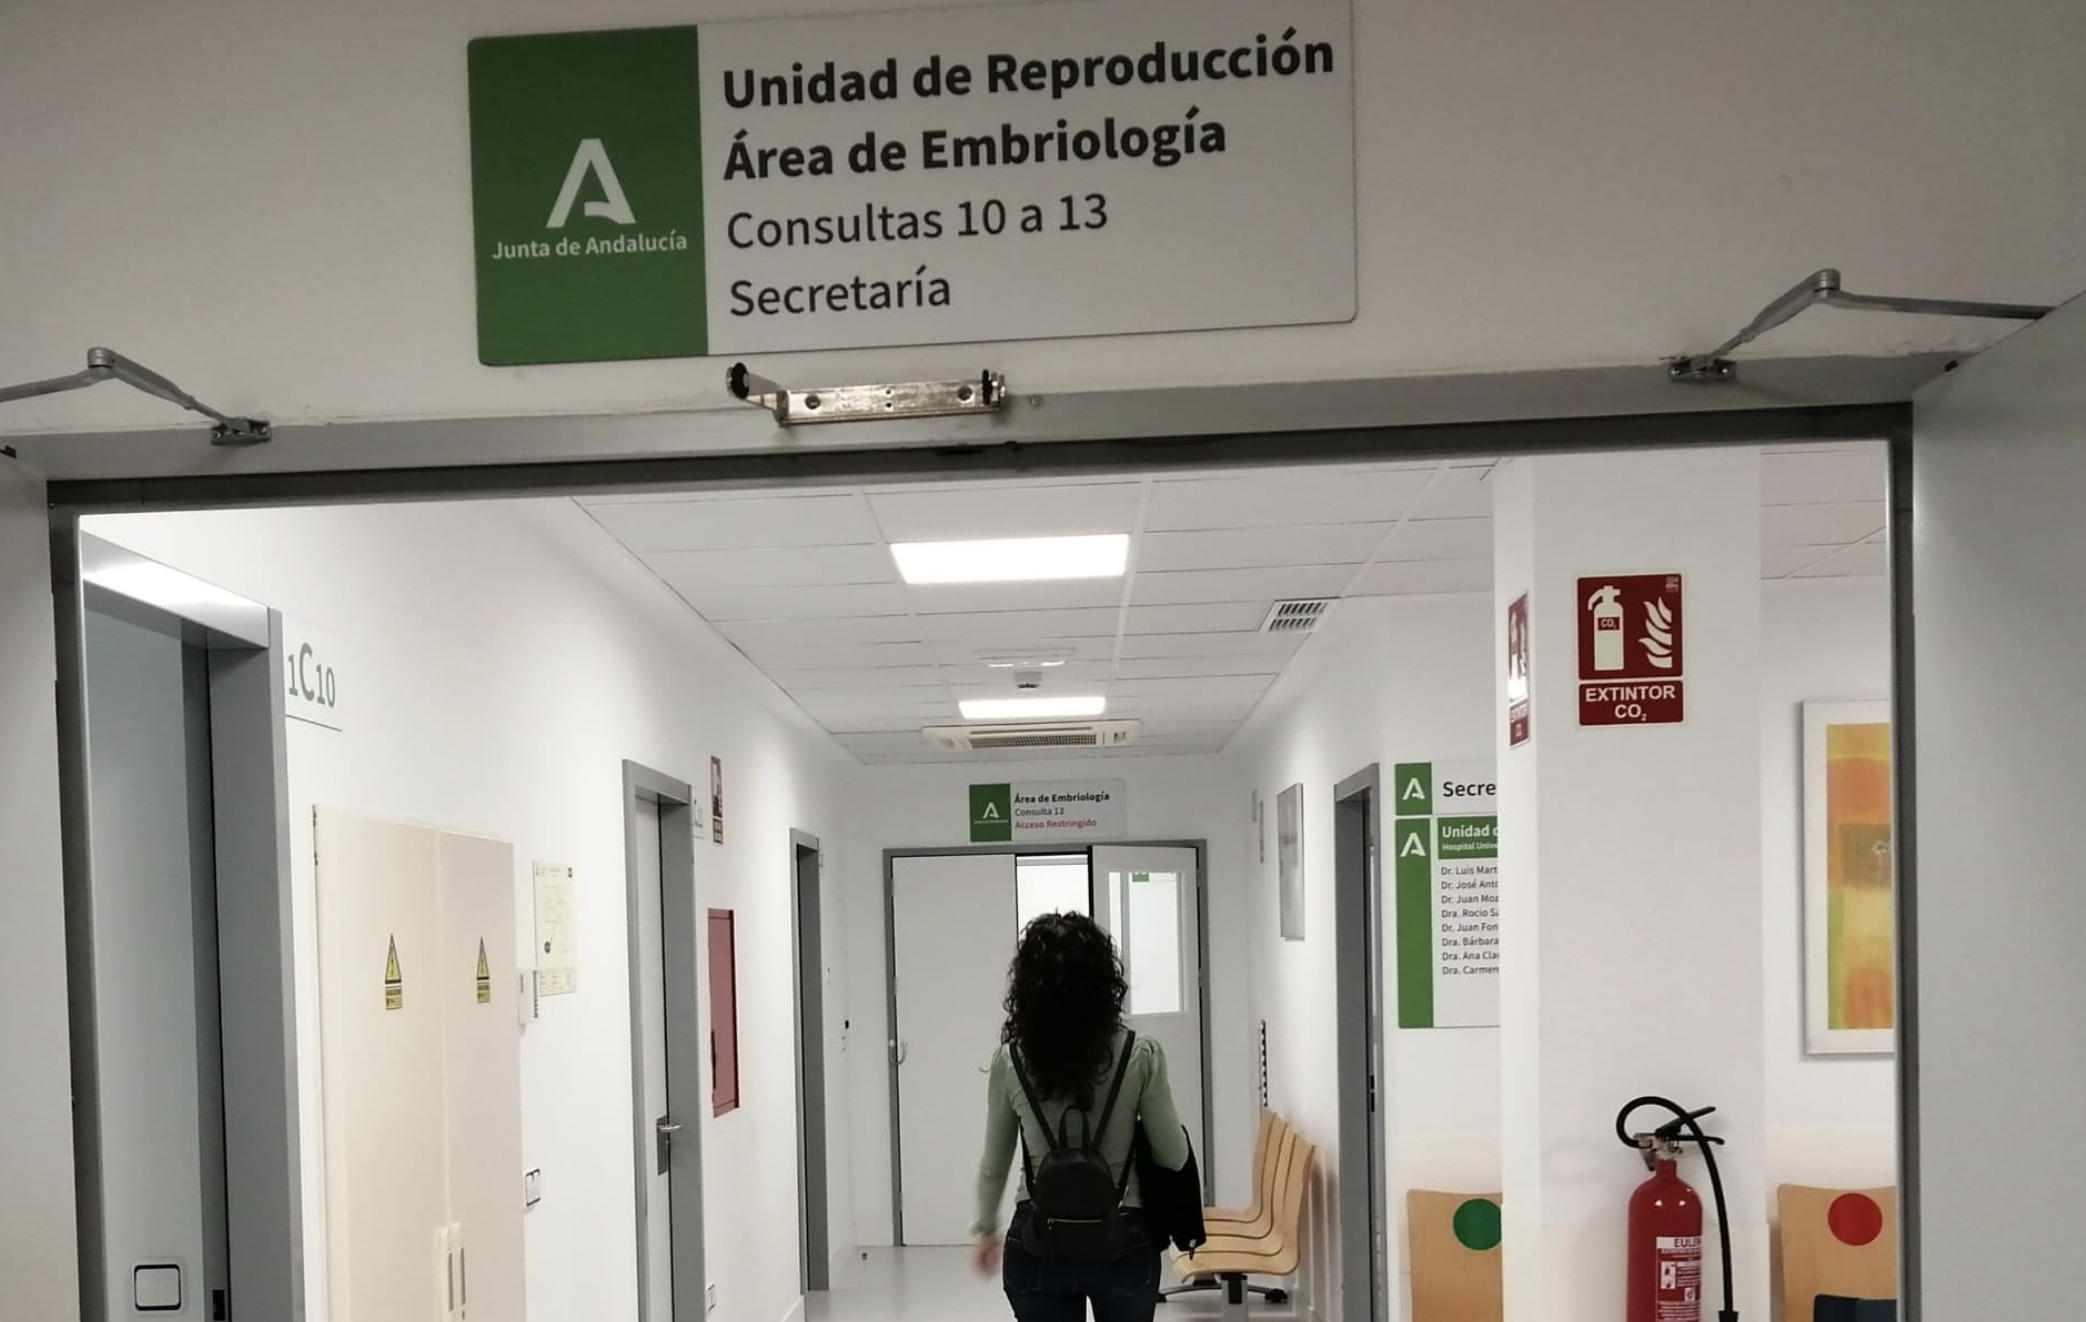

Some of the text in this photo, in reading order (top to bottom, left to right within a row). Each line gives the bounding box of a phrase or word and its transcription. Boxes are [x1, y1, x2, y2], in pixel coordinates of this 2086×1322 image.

[723, 26, 1333, 109] Unidad de Reproducción
[723, 105, 1226, 180] Área de Embriología
[727, 194, 1108, 249] Consultas 10 a 13
[492, 229, 688, 259] Junta de Andalucía
[730, 264, 951, 316] Secretaría
[288, 642, 335, 709] 1C10
[1585, 685, 1675, 702] EXTINTOR
[1614, 704, 1646, 722] CO2
[1442, 781, 1496, 798] Secre
[1015, 790, 1110, 804] Área de Embriología
[1015, 807, 1065, 817] Consulta 13
[1015, 821, 1044, 829] Acceso
[1046, 819, 1097, 829] Restringido
[1442, 824, 1490, 838] Unidad
[1442, 841, 1475, 852] Hospital
[1441, 867, 1453, 876] Dr.
[1456, 867, 1474, 875] Luis
[1441, 881, 1453, 890] Dr.
[1456, 879, 1477, 889] José
[1441, 895, 1453, 904] Dr.
[1456, 895, 1479, 903] Juan
[1441, 909, 1459, 918] Dra.
[1462, 909, 1488, 917] Rocio
[1441, 923, 1454, 932] Dr.
[1457, 923, 1480, 931] Juan
[1443, 936, 1499, 946] Dra. Bárbara
[1443, 952, 1460, 961] Dra.
[1463, 952, 1480, 960] Ana
[1443, 965, 1499, 975] Dra. Carmen
